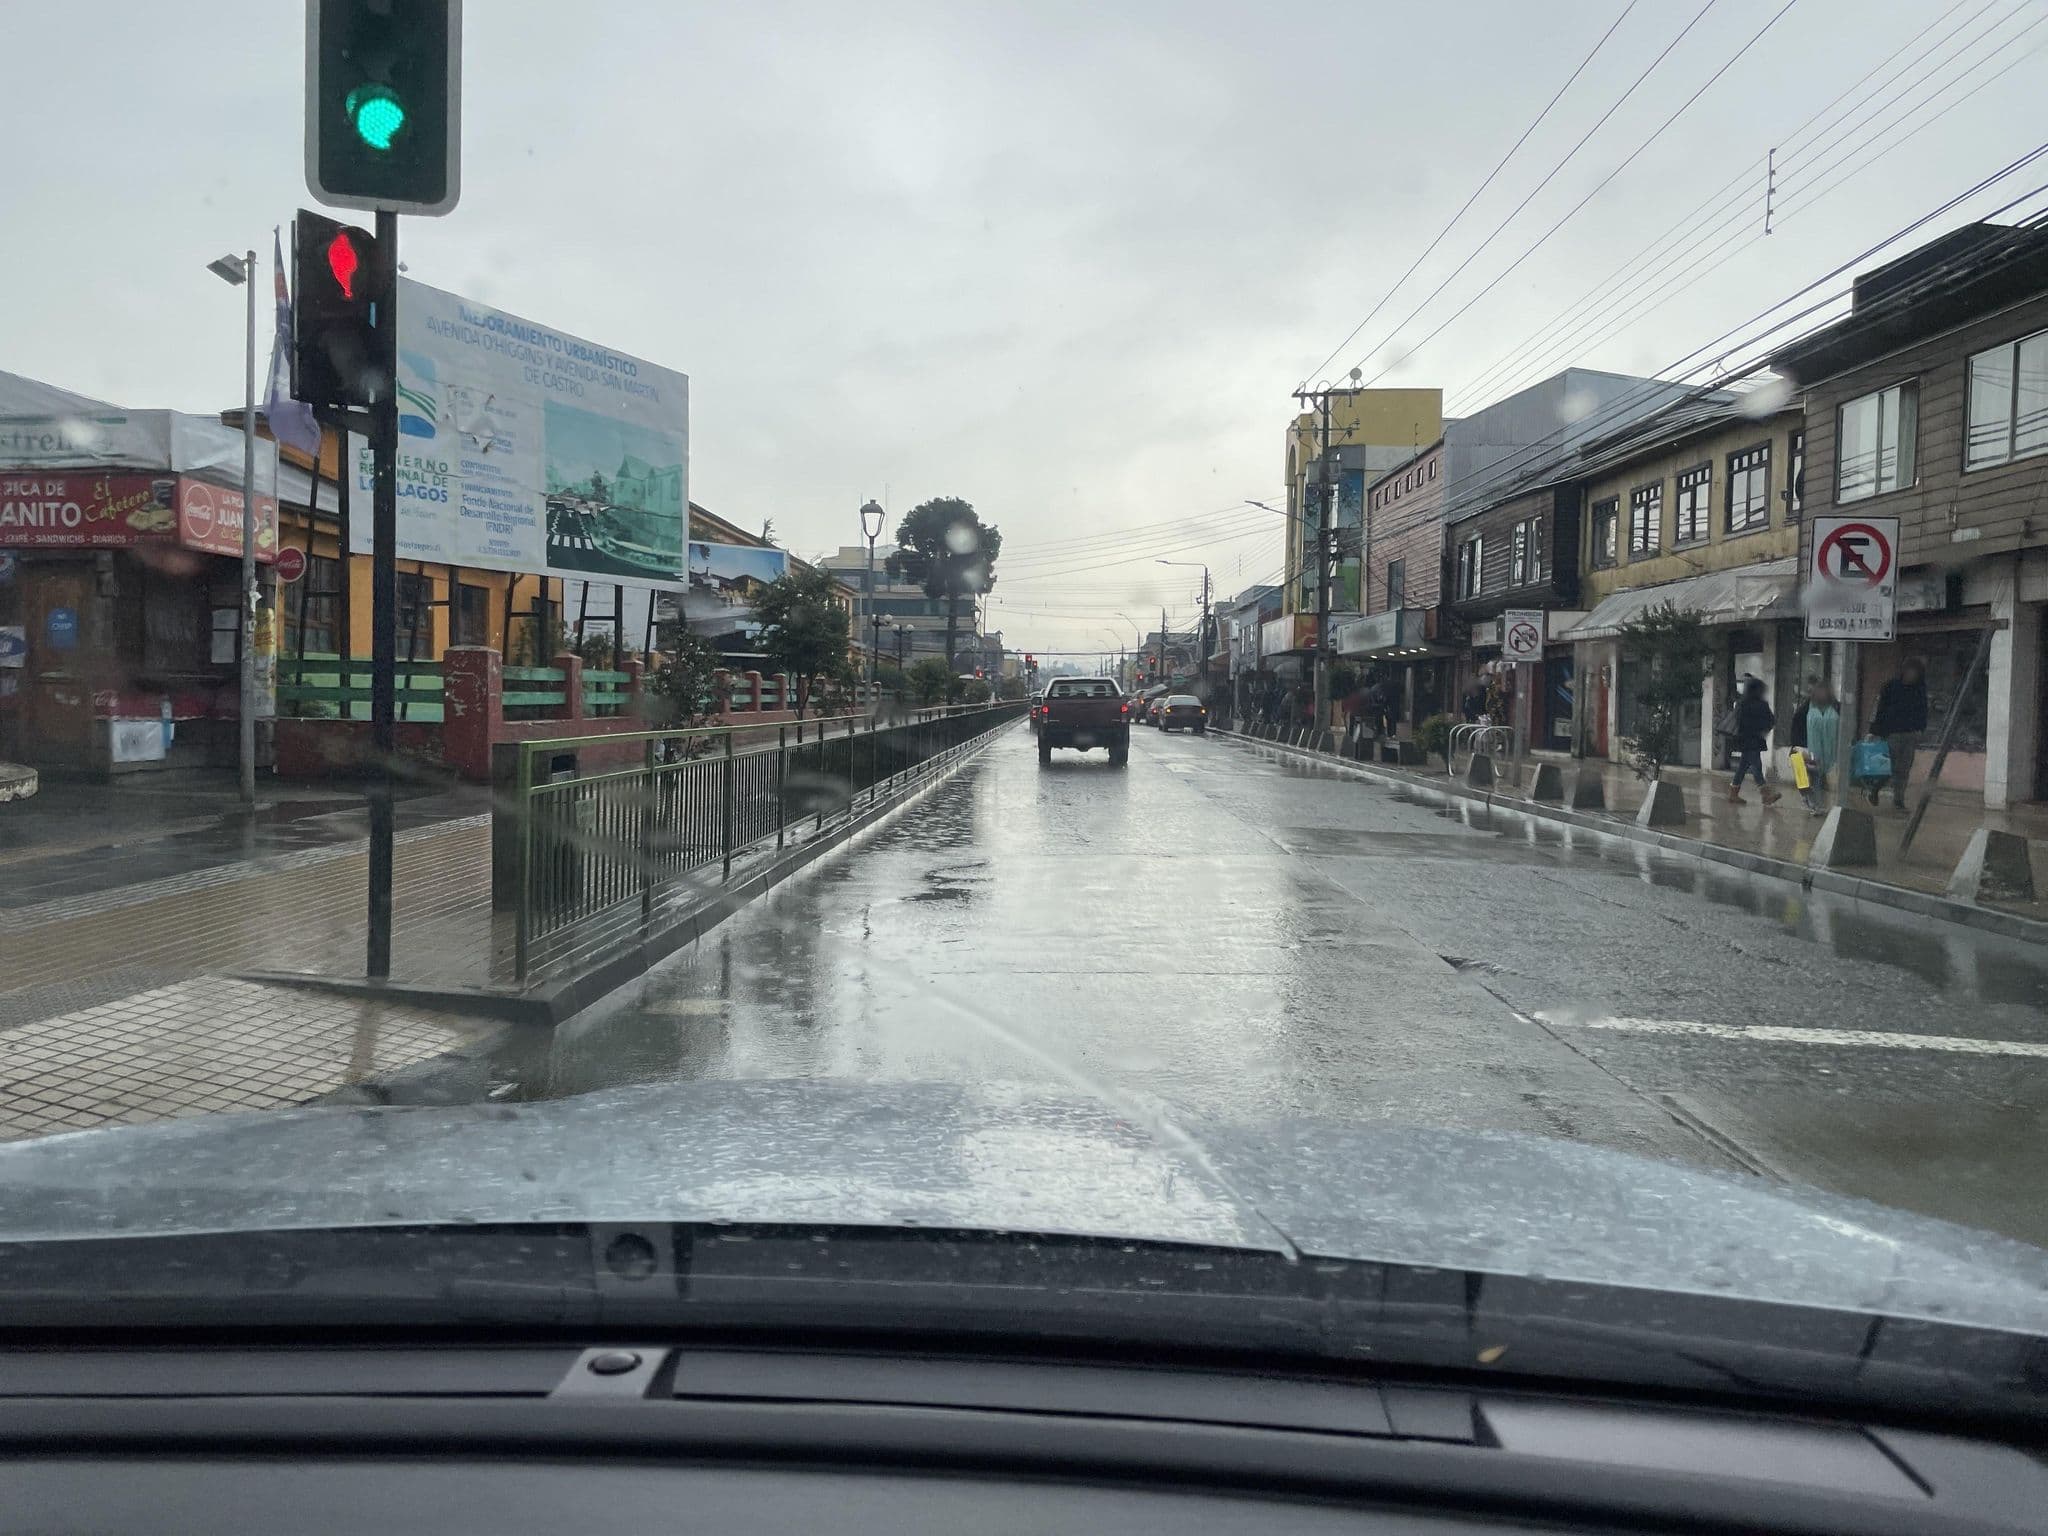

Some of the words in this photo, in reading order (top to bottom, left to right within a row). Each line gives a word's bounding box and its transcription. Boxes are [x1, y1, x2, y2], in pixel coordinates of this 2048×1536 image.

[426, 315, 480, 345] AVENIDA
[482, 333, 544, 366] O'HIGGINS
[556, 357, 600, 382] AVENIDA
[601, 371, 622, 391] SAN
[458, 303, 561, 352] MEJORAMIENTO
[564, 340, 637, 377] URBANÍSTICO
[524, 366, 539, 385] DE
[543, 371, 585, 398] CASTRO
[45, 481, 66, 496] DE
[396, 482, 449, 504] LAGOS
[432, 475, 449, 488] DE
